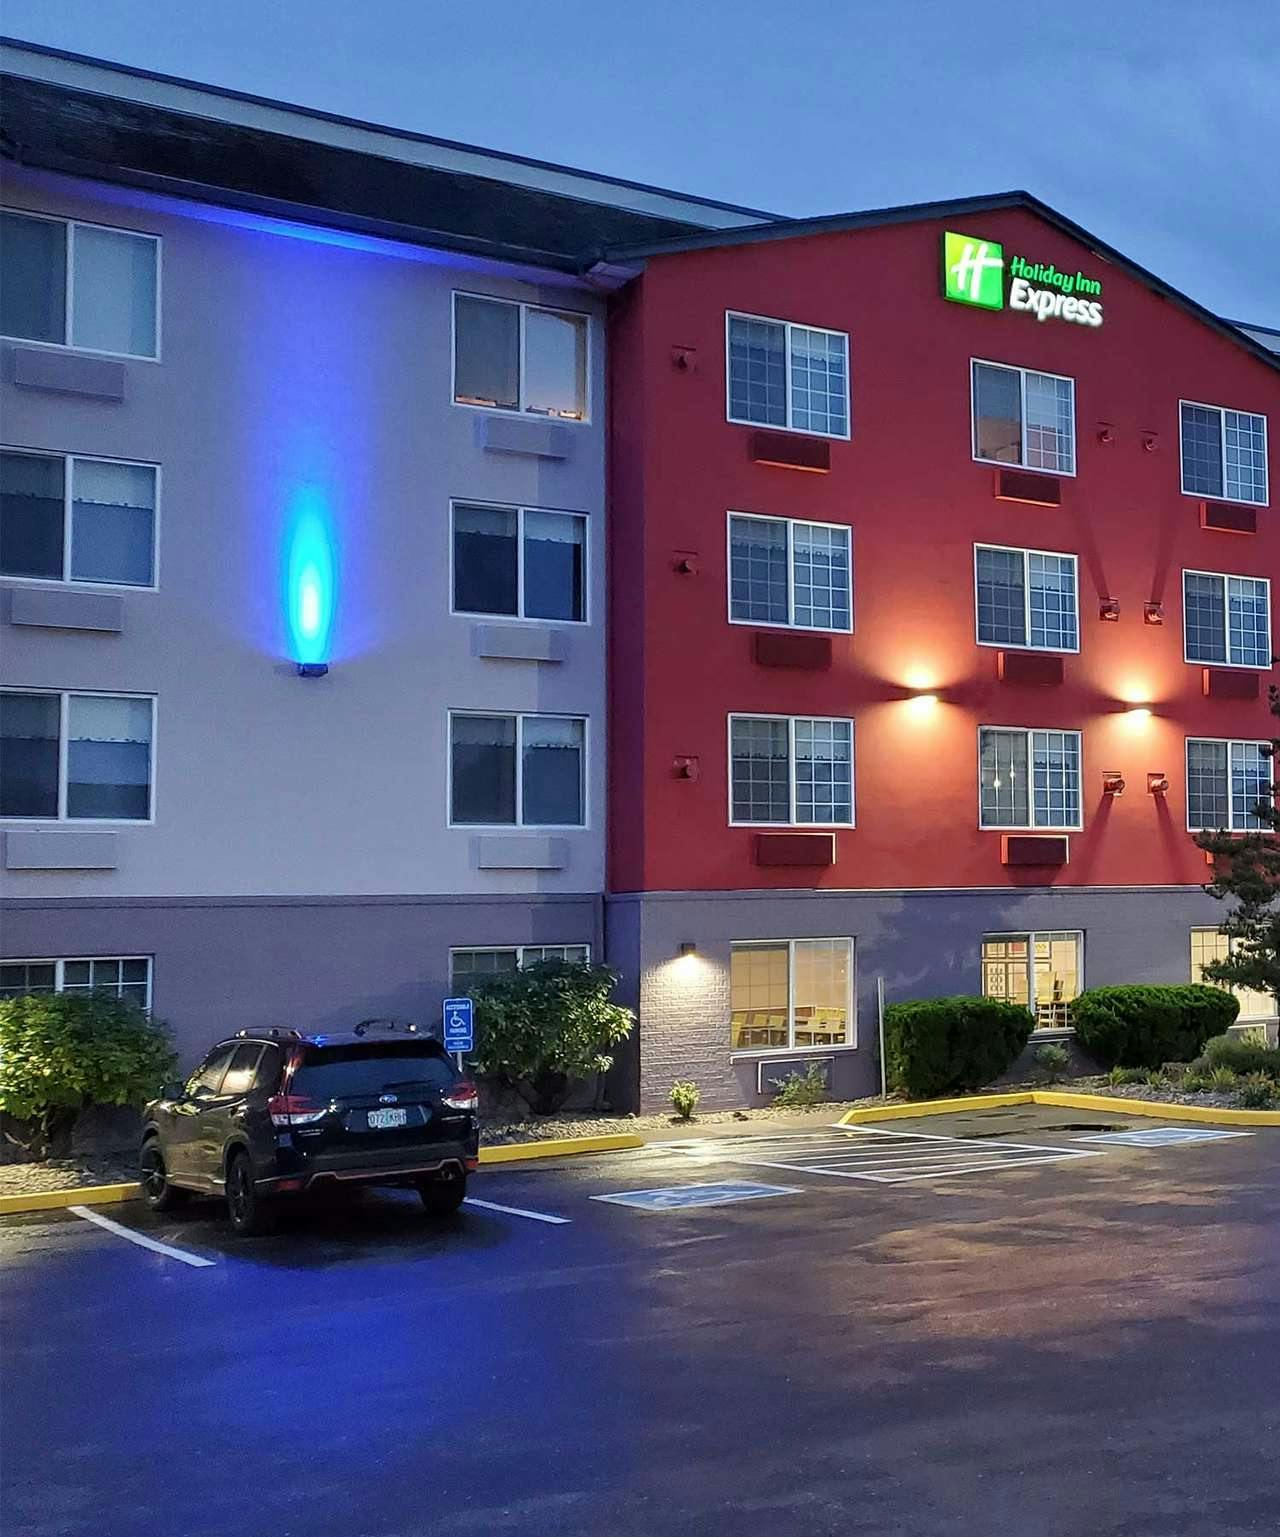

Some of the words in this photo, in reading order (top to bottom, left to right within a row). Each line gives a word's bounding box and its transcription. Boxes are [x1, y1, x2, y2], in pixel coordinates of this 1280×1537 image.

[1010, 255, 1074, 293] Holiday
[1075, 271, 1102, 295] Inn
[1009, 277, 1103, 327] Express
